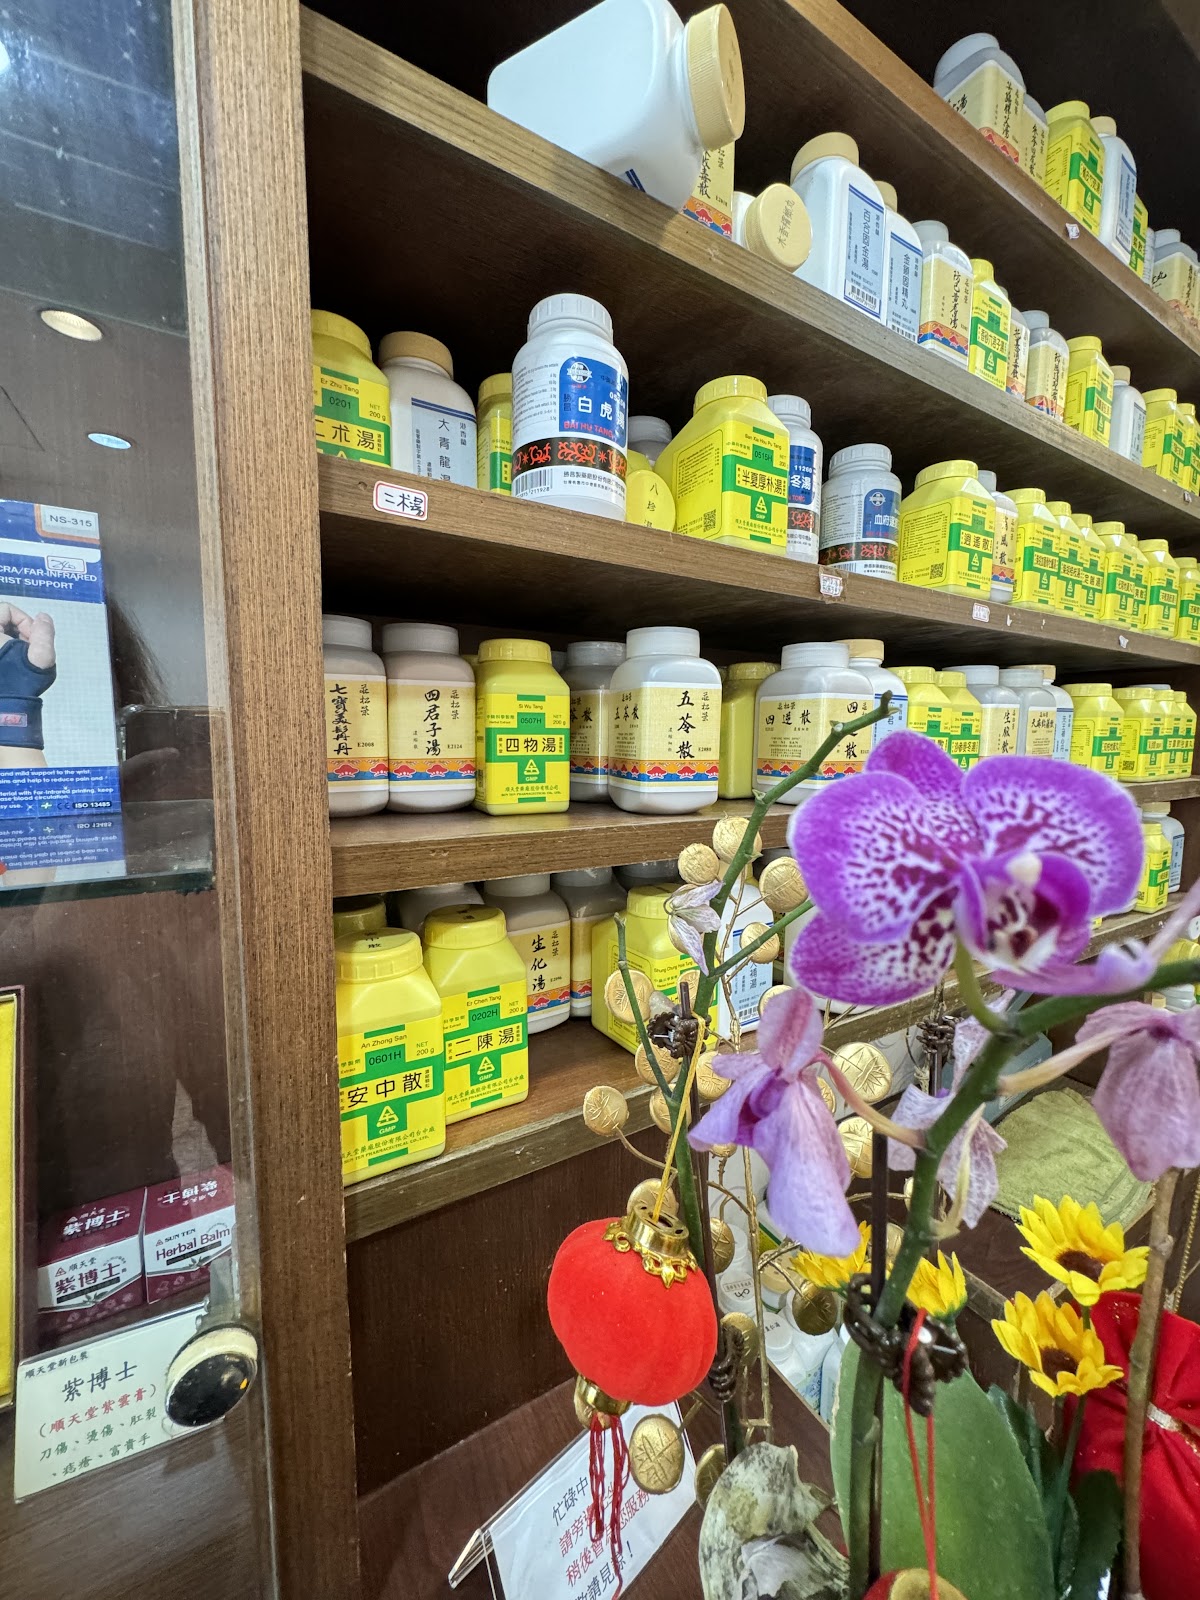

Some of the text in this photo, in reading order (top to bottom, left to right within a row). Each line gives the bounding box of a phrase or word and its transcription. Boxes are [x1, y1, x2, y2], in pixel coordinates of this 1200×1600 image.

[563, 420, 579, 429] BAI
[742, 469, 783, 496] 半夏厚朴湯
[789, 474, 812, 491] 冬湯
[50, 514, 92, 527] NS-315
[24, 578, 74, 590] SUPPORT
[423, 689, 442, 757] 四君子湯
[676, 690, 696, 760] 五苓散
[765, 709, 812, 726] 四逆散
[844, 701, 859, 760] 四散
[506, 737, 556, 753] 四物湯
[31, 769, 56, 777] support
[530, 934, 548, 991] 生化湯
[474, 997, 489, 1006] Chen
[471, 1008, 498, 1022] 0202H
[371, 1036, 393, 1047] Zhong
[394, 1033, 408, 1042] San
[416, 1040, 429, 1048] NET
[455, 1027, 515, 1057] 二陳湯
[368, 1050, 402, 1066] 0601H
[416, 1047, 435, 1056] 200 g
[478, 1073, 493, 1082] GMP
[347, 1071, 423, 1108] 安中散
[378, 1125, 396, 1135] GMP
[365, 1141, 409, 1158] PHARMACEUTICAL
[164, 1228, 197, 1243] SUN TEN
[156, 1228, 231, 1261] Herbal Balm
[69, 1256, 98, 1271] 順天堂
[55, 1262, 122, 1295] 紫博士
[25, 1350, 89, 1379] 順天堂新包裝
[61, 1360, 138, 1403] 紫博士
[553, 1476, 589, 1527] 忙碌中
